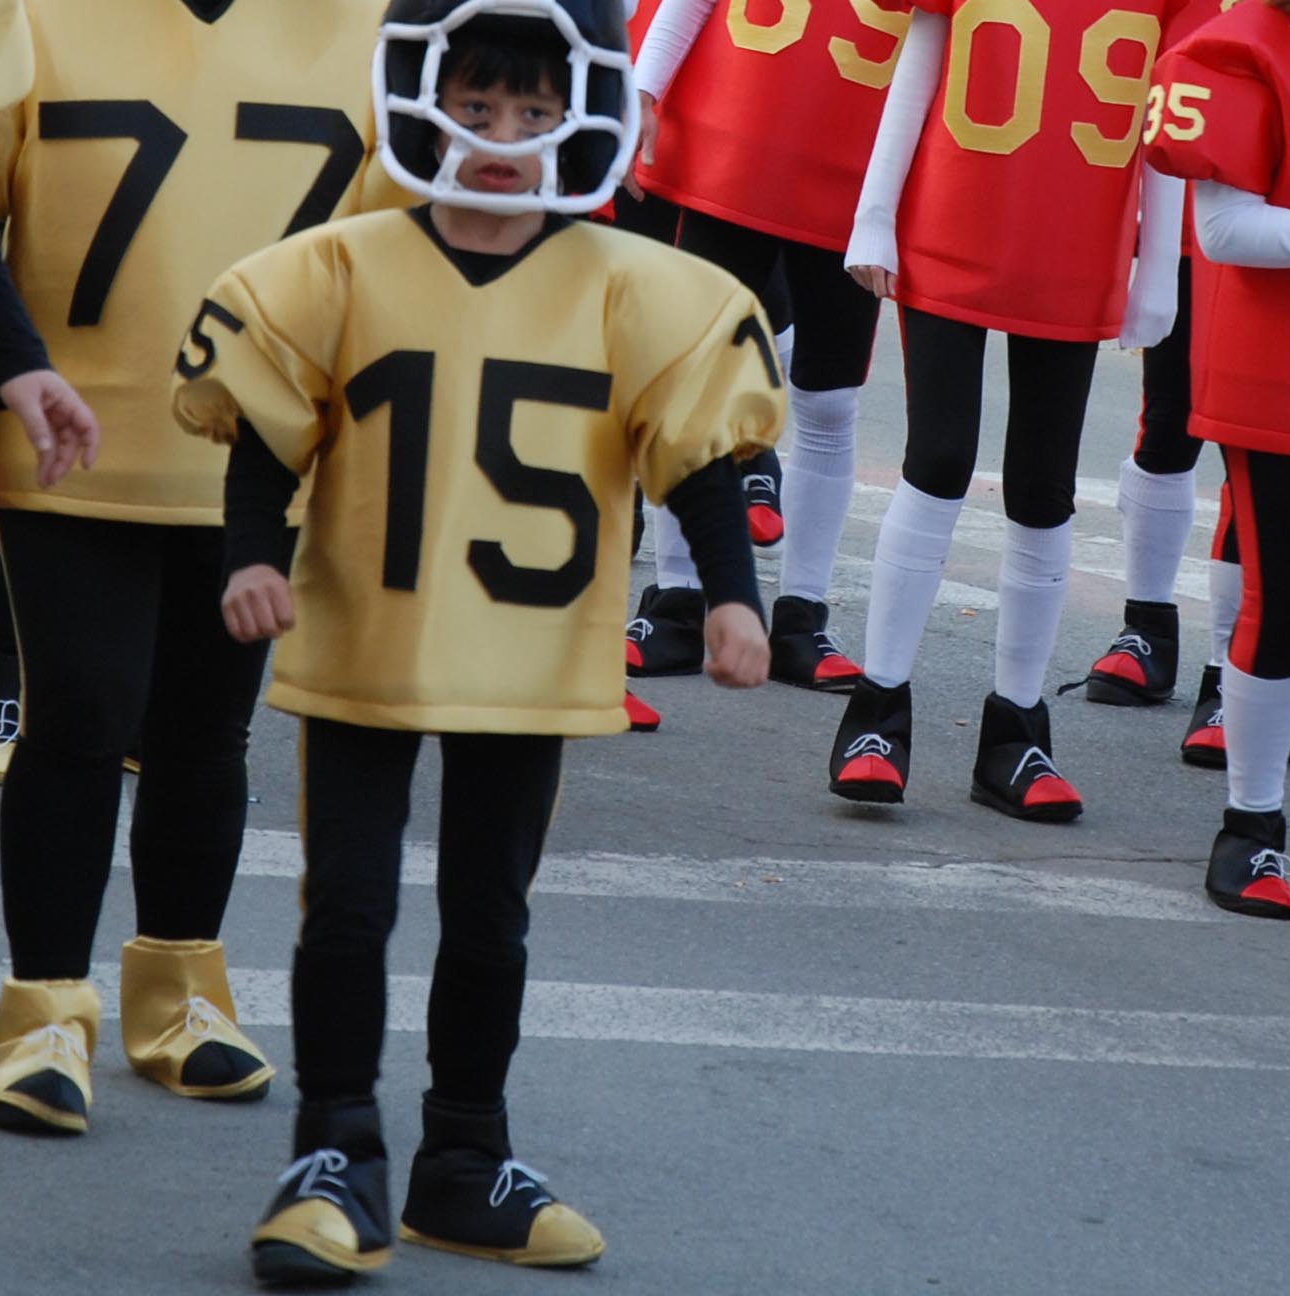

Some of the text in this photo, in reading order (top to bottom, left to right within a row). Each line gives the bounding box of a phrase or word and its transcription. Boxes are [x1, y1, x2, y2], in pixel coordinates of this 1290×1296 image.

[1143, 83, 1211, 145] 35
[39, 100, 365, 327] 77
[175, 298, 245, 381] 5
[732, 315, 782, 388] 1
[344, 349, 613, 608] 15
